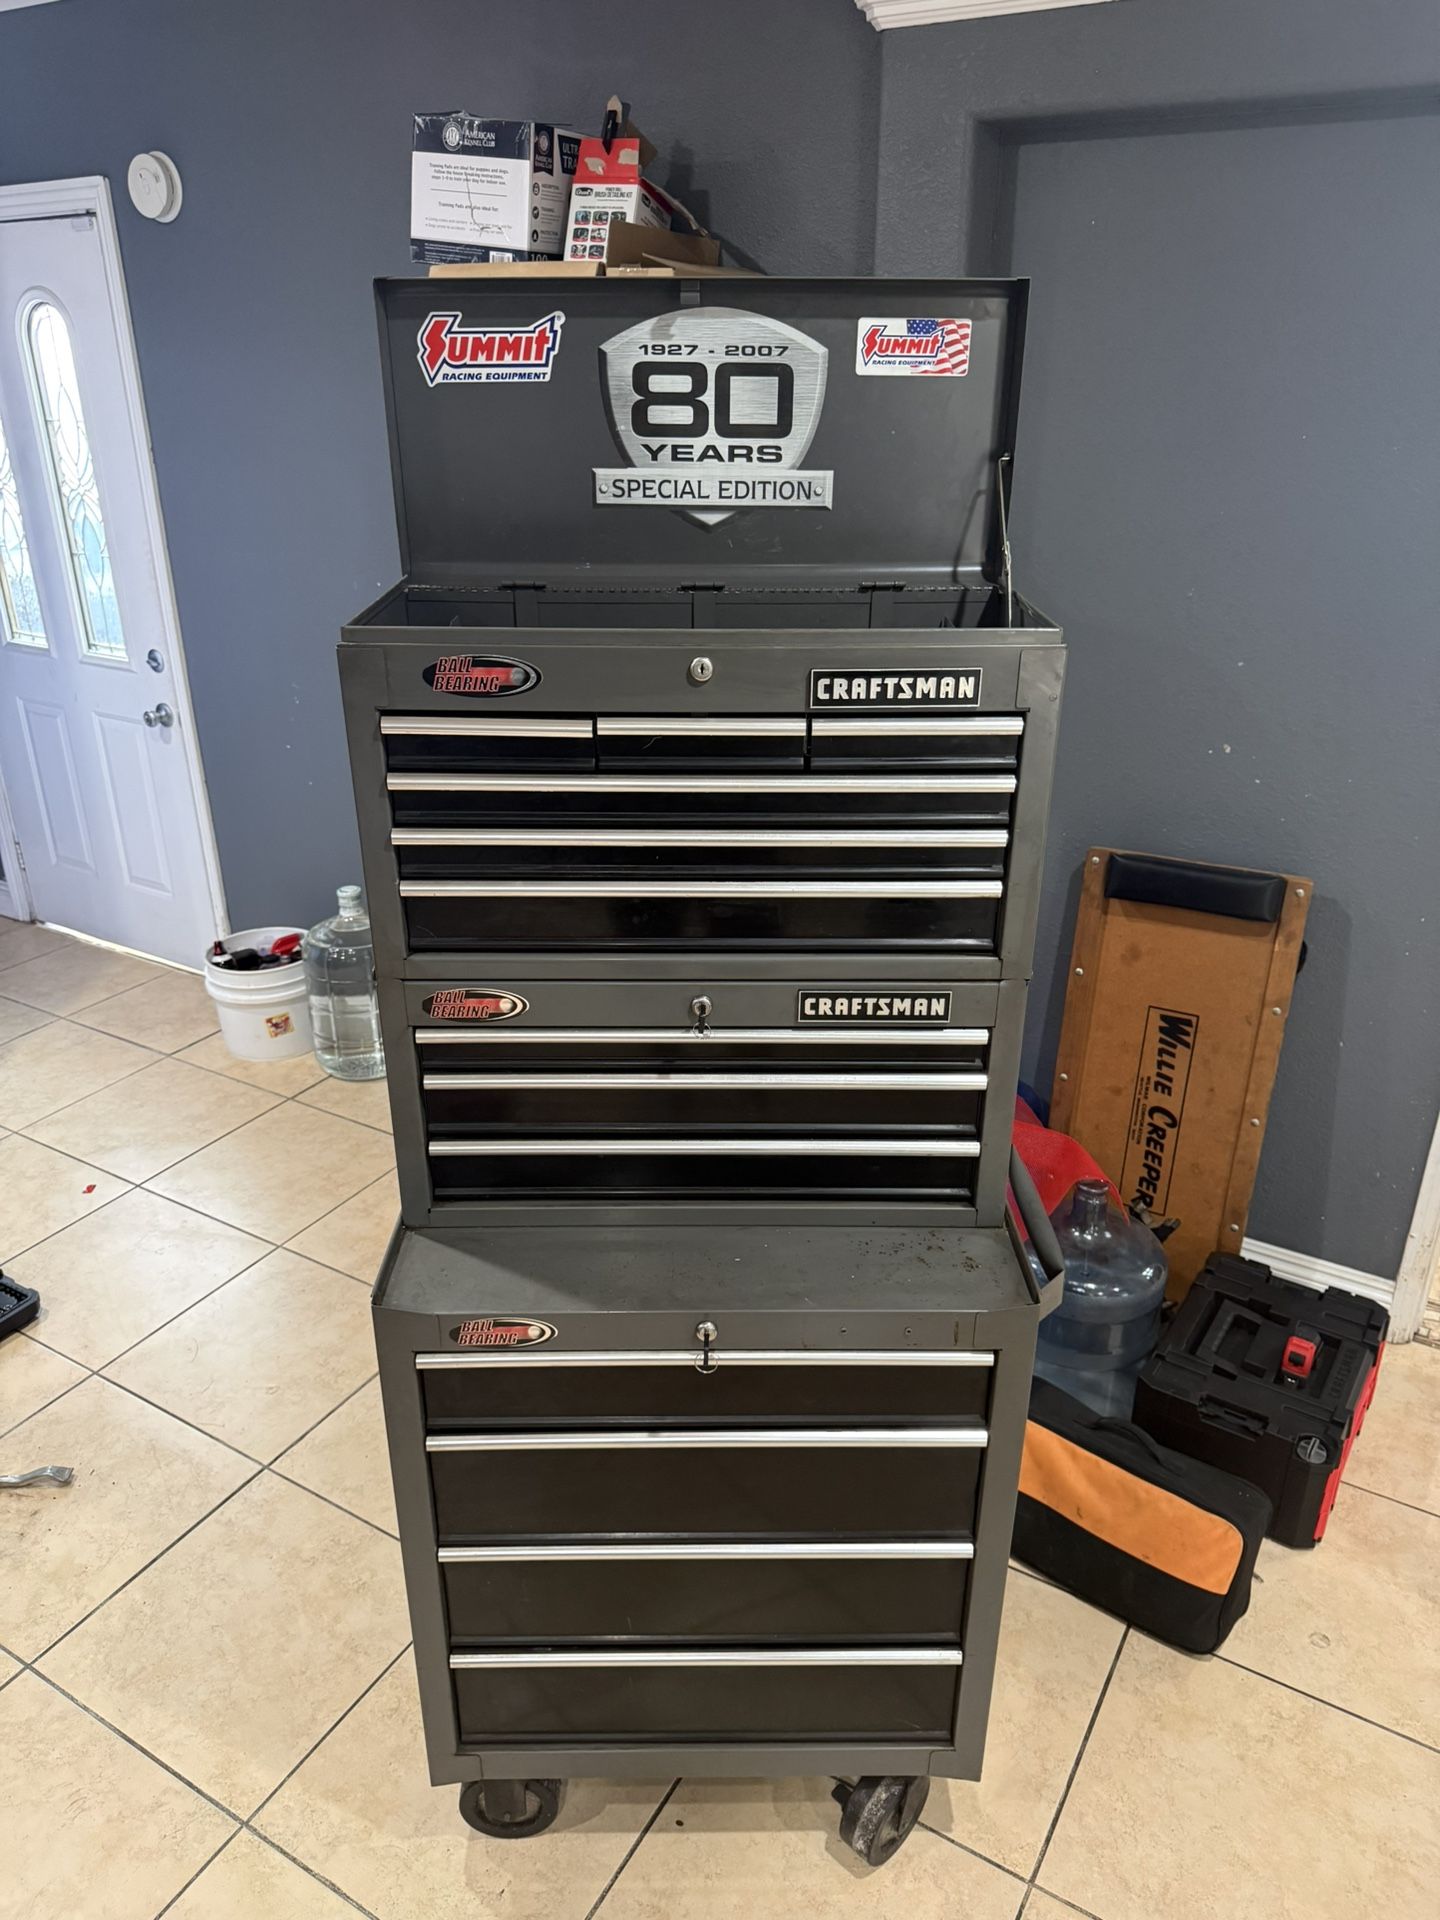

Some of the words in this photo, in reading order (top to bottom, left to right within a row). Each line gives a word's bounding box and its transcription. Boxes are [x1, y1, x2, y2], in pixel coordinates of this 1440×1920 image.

[463, 129, 496, 141] AMERICAN
[463, 138, 482, 147] KENNEL
[482, 139, 496, 148] CLUB
[638, 344, 699, 356] 1927
[724, 345, 789, 357] 2007
[442, 372, 483, 381] RACING
[485, 372, 548, 380] EQUIPMENT
[631, 361, 795, 439] 80
[640, 443, 783, 463] YEARS
[611, 479, 709, 499] SPECIAL
[718, 480, 812, 500] EDITION
[435, 656, 473, 673] BALL
[433, 674, 500, 692] BEARING
[817, 676, 975, 700] CRAFTSMAN
[432, 990, 466, 1004] BALL
[430, 1004, 490, 1019] BEARING
[804, 997, 946, 1016] CRAFTSMAN
[460, 1320, 494, 1332] BALL
[458, 1332, 519, 1345] BEARING
